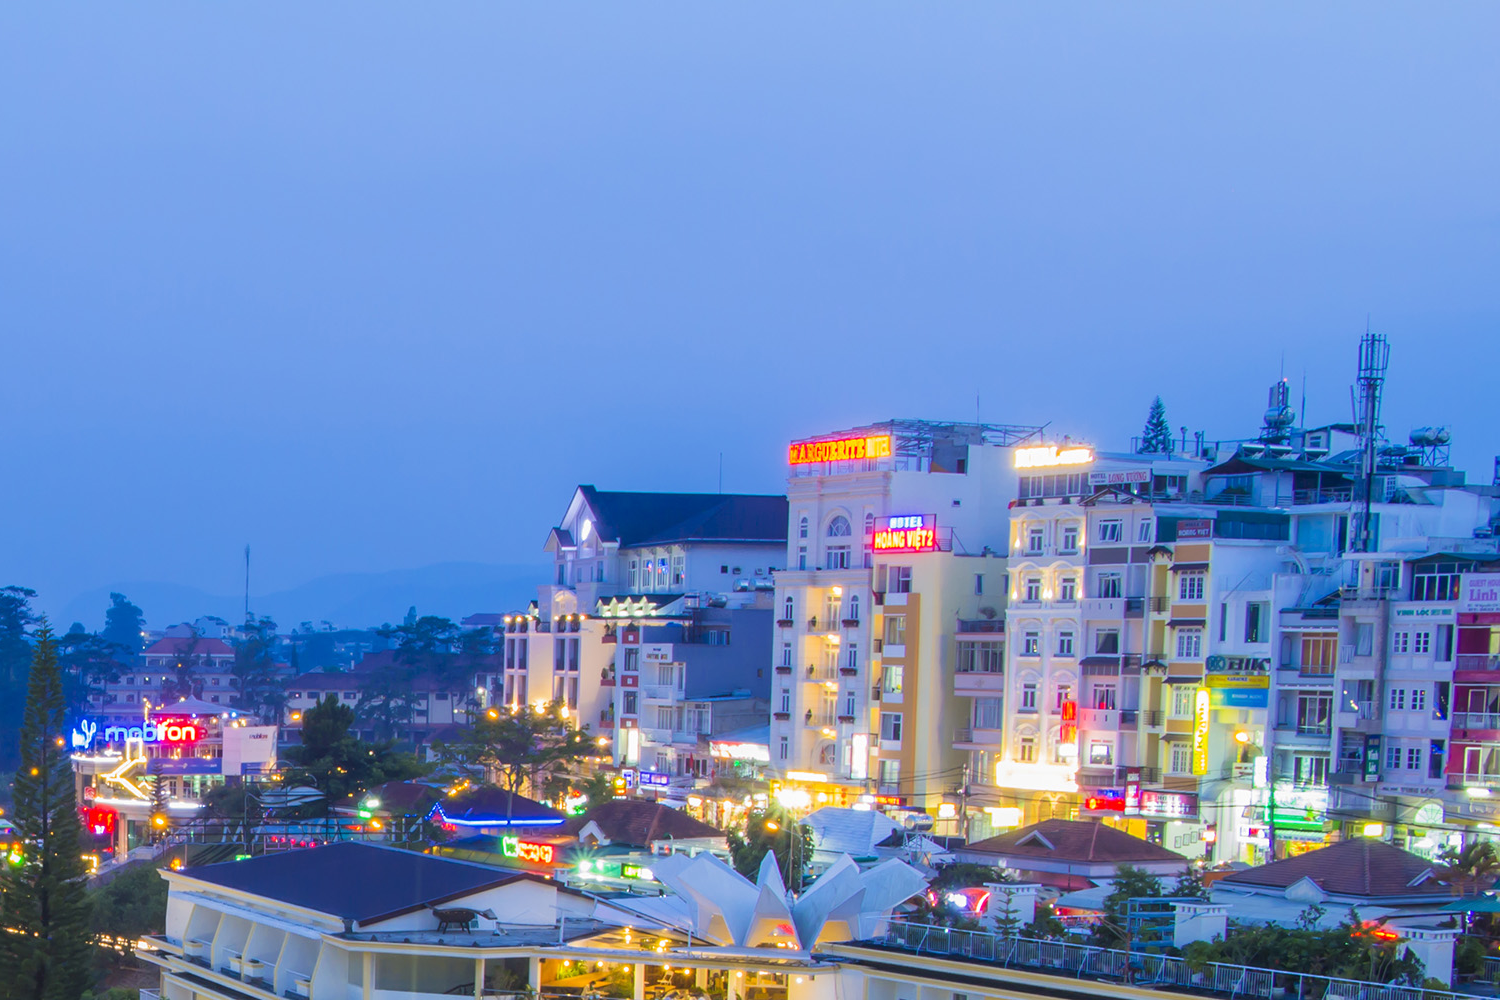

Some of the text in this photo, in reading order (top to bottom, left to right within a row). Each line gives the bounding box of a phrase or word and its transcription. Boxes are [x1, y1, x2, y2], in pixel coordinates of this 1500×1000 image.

[789, 438, 865, 464] MARGUERITE
[890, 516, 923, 529] HOTEL
[874, 528, 906, 549] HOÀNG
[1469, 588, 1498, 602] Linh
